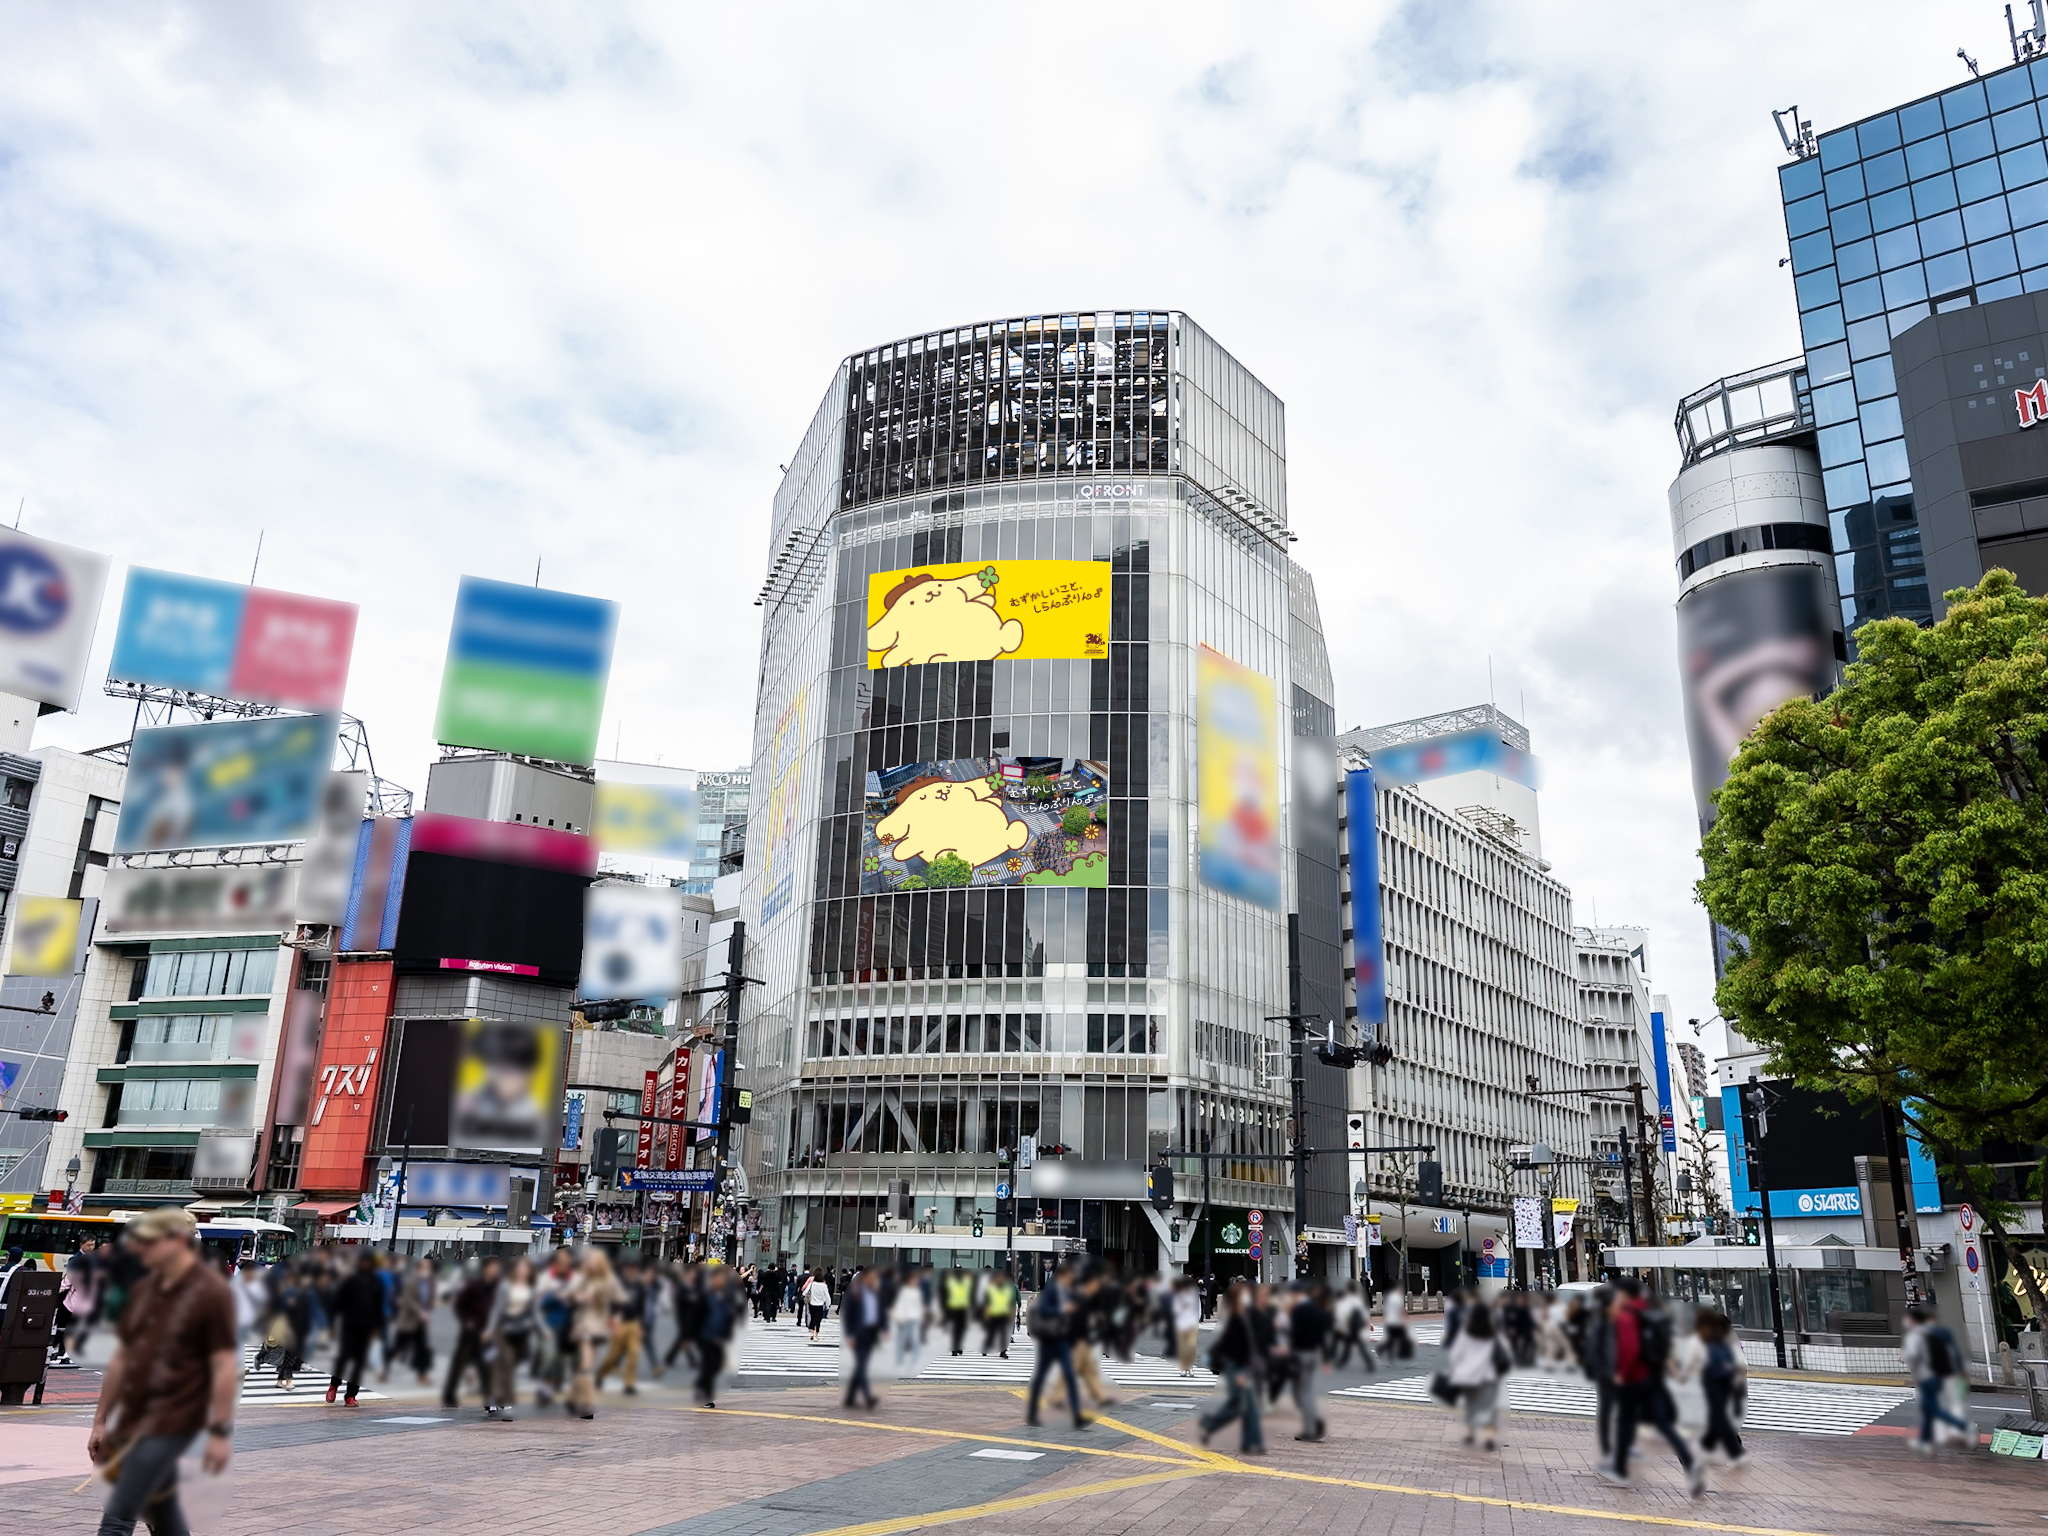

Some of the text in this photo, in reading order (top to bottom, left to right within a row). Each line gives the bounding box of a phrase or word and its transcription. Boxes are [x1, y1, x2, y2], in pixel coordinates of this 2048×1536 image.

[468, 961, 512, 971] Rakuten Vision
[311, 1047, 379, 1127] クスリ
[671, 1056, 689, 1116] カラオケ
[637, 1121, 652, 1169] カラオケ
